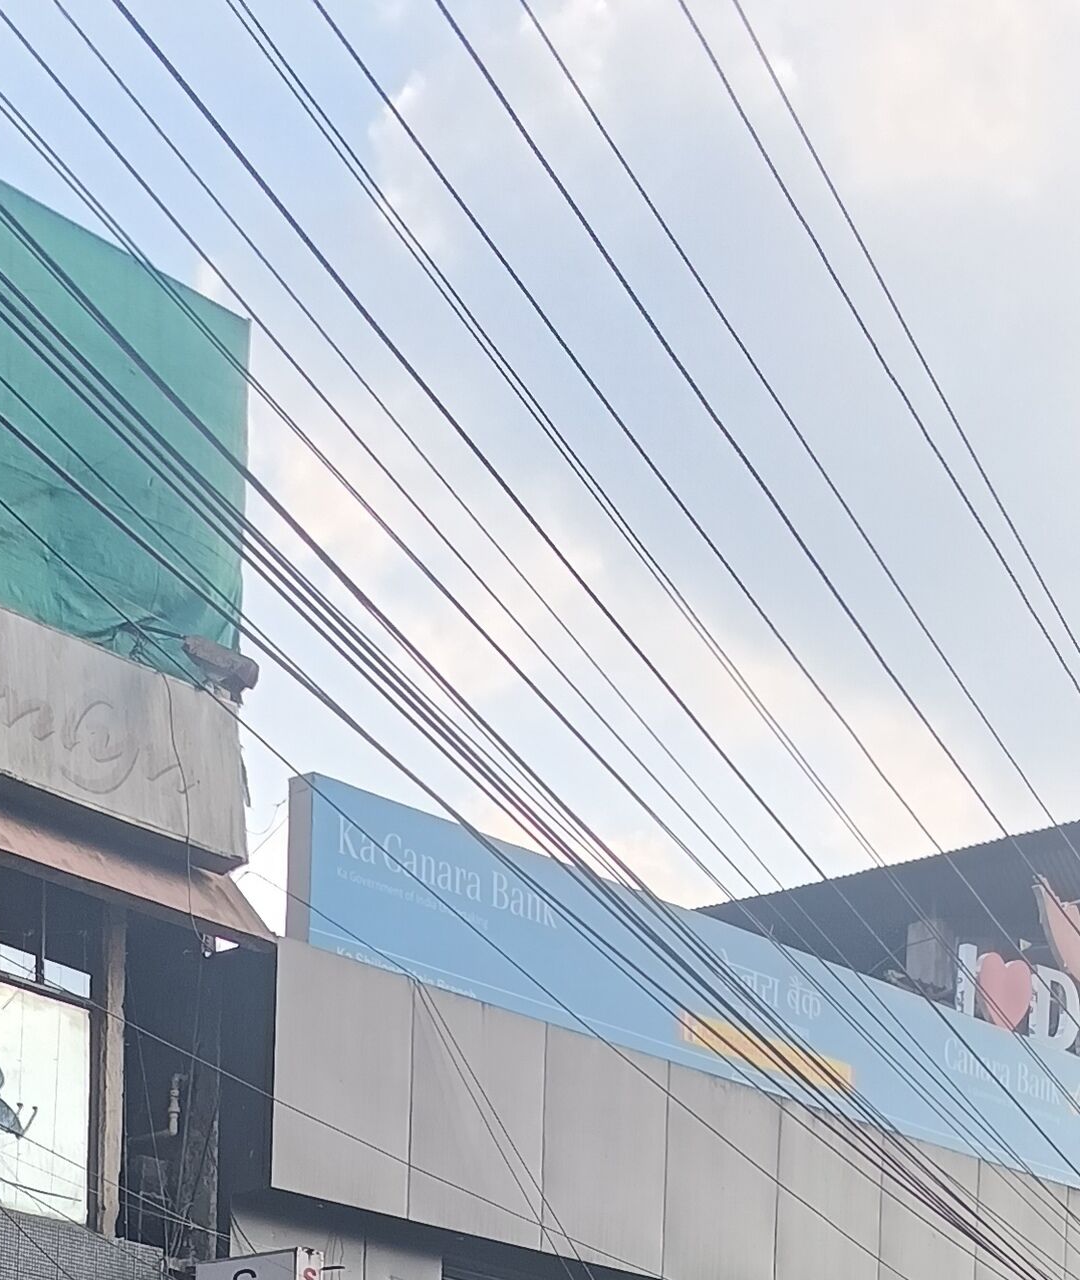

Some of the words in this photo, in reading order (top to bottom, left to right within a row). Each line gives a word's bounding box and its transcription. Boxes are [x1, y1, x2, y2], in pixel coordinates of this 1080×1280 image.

[383, 831, 482, 903] Canara
[491, 870, 558, 929] Bank
[943, 1037, 1011, 1090] Canara
[1017, 1062, 1062, 1105] Bank
